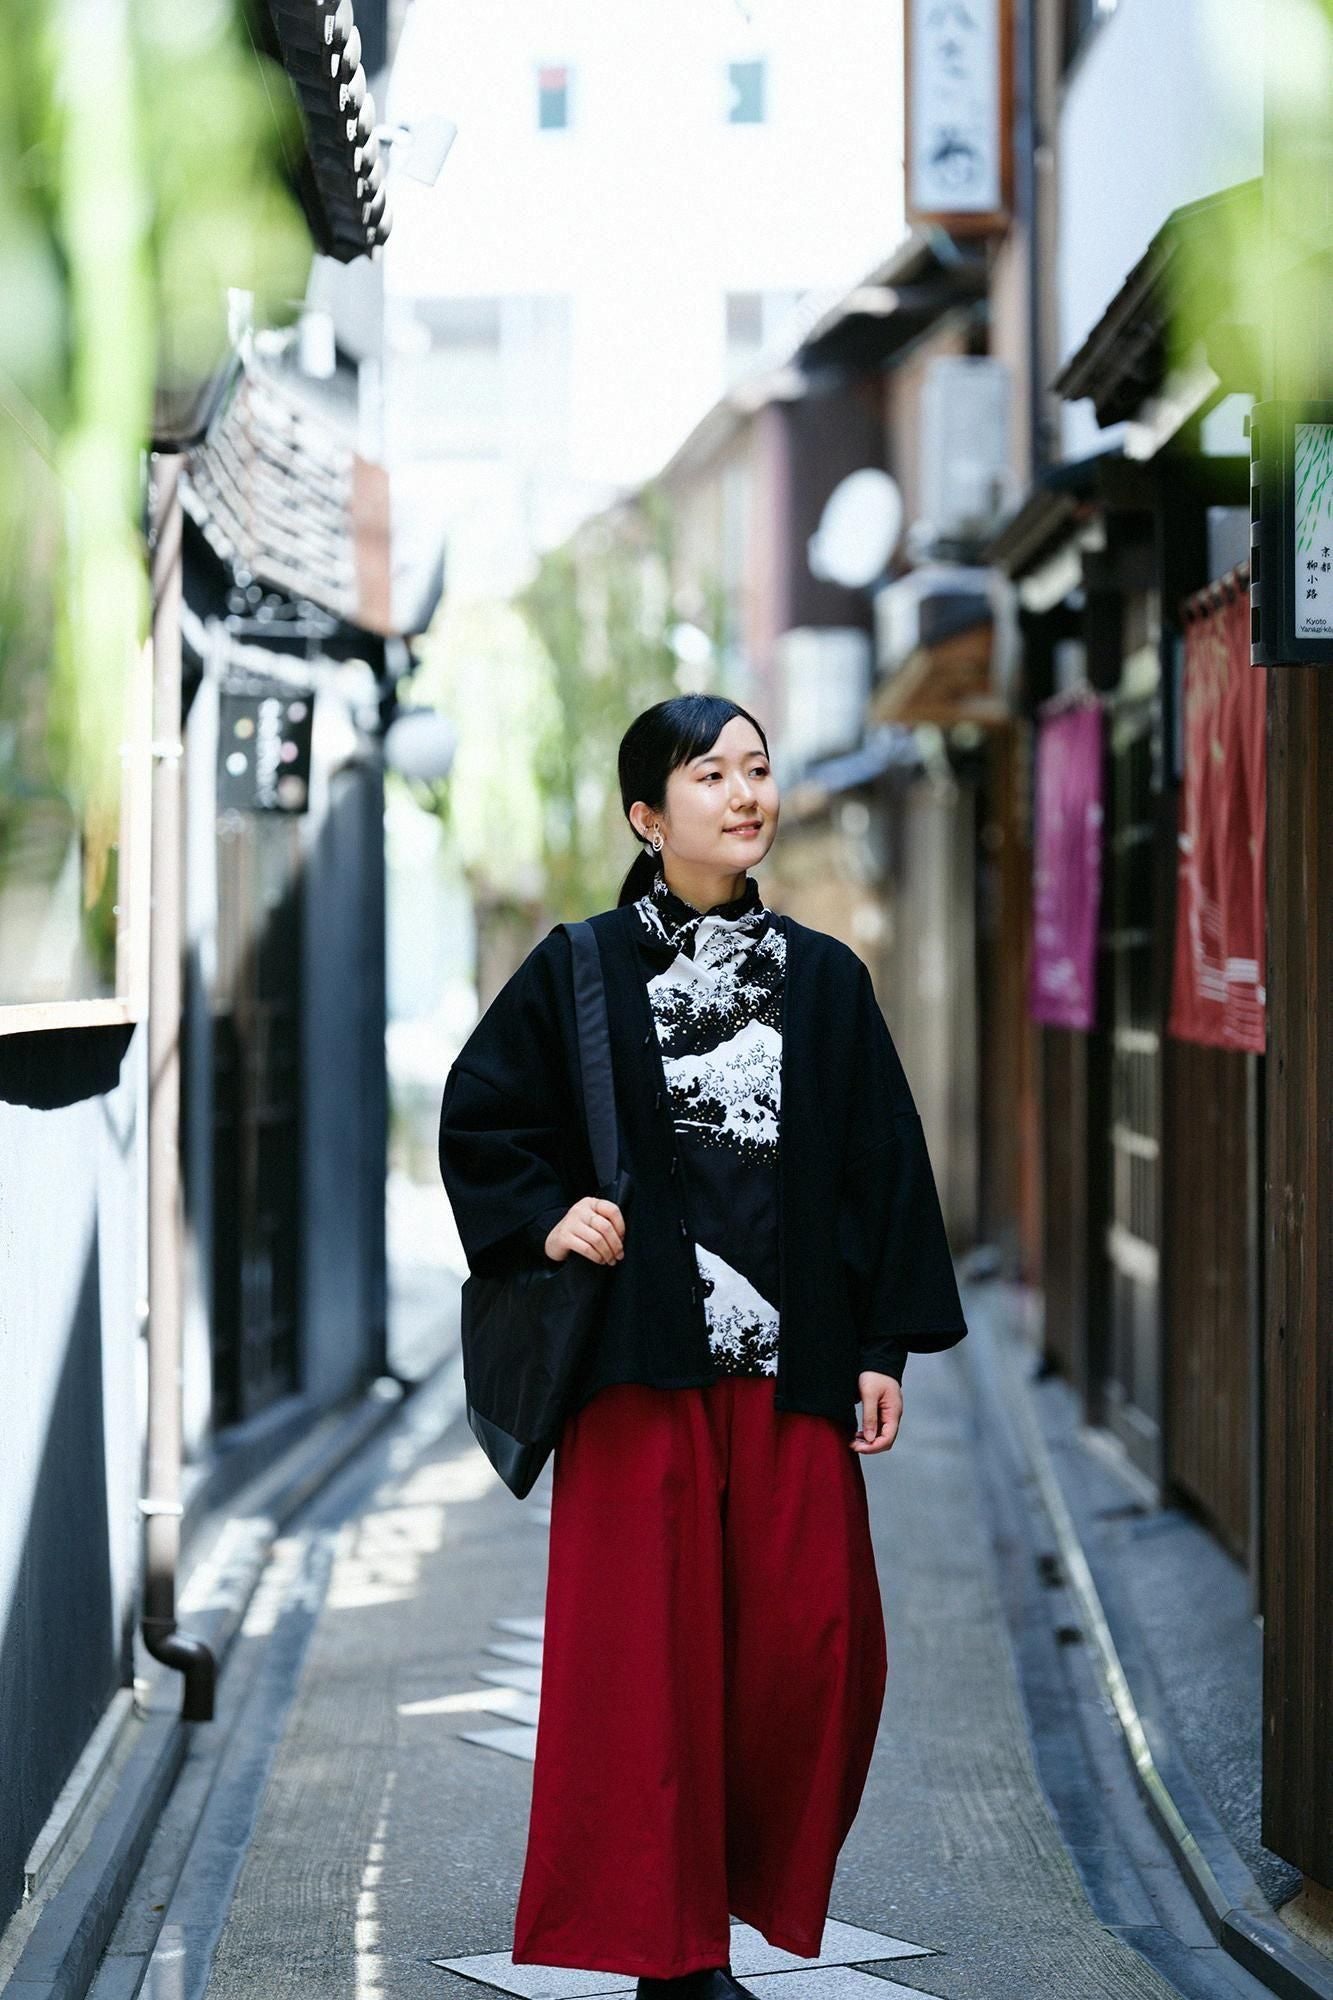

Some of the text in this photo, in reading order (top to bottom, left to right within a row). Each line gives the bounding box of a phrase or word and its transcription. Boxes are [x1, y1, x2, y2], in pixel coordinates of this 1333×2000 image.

[1321, 546, 1331, 573] 京都
[1306, 560, 1318, 600] 柳小路
[1305, 618, 1327, 626] Kyoto
